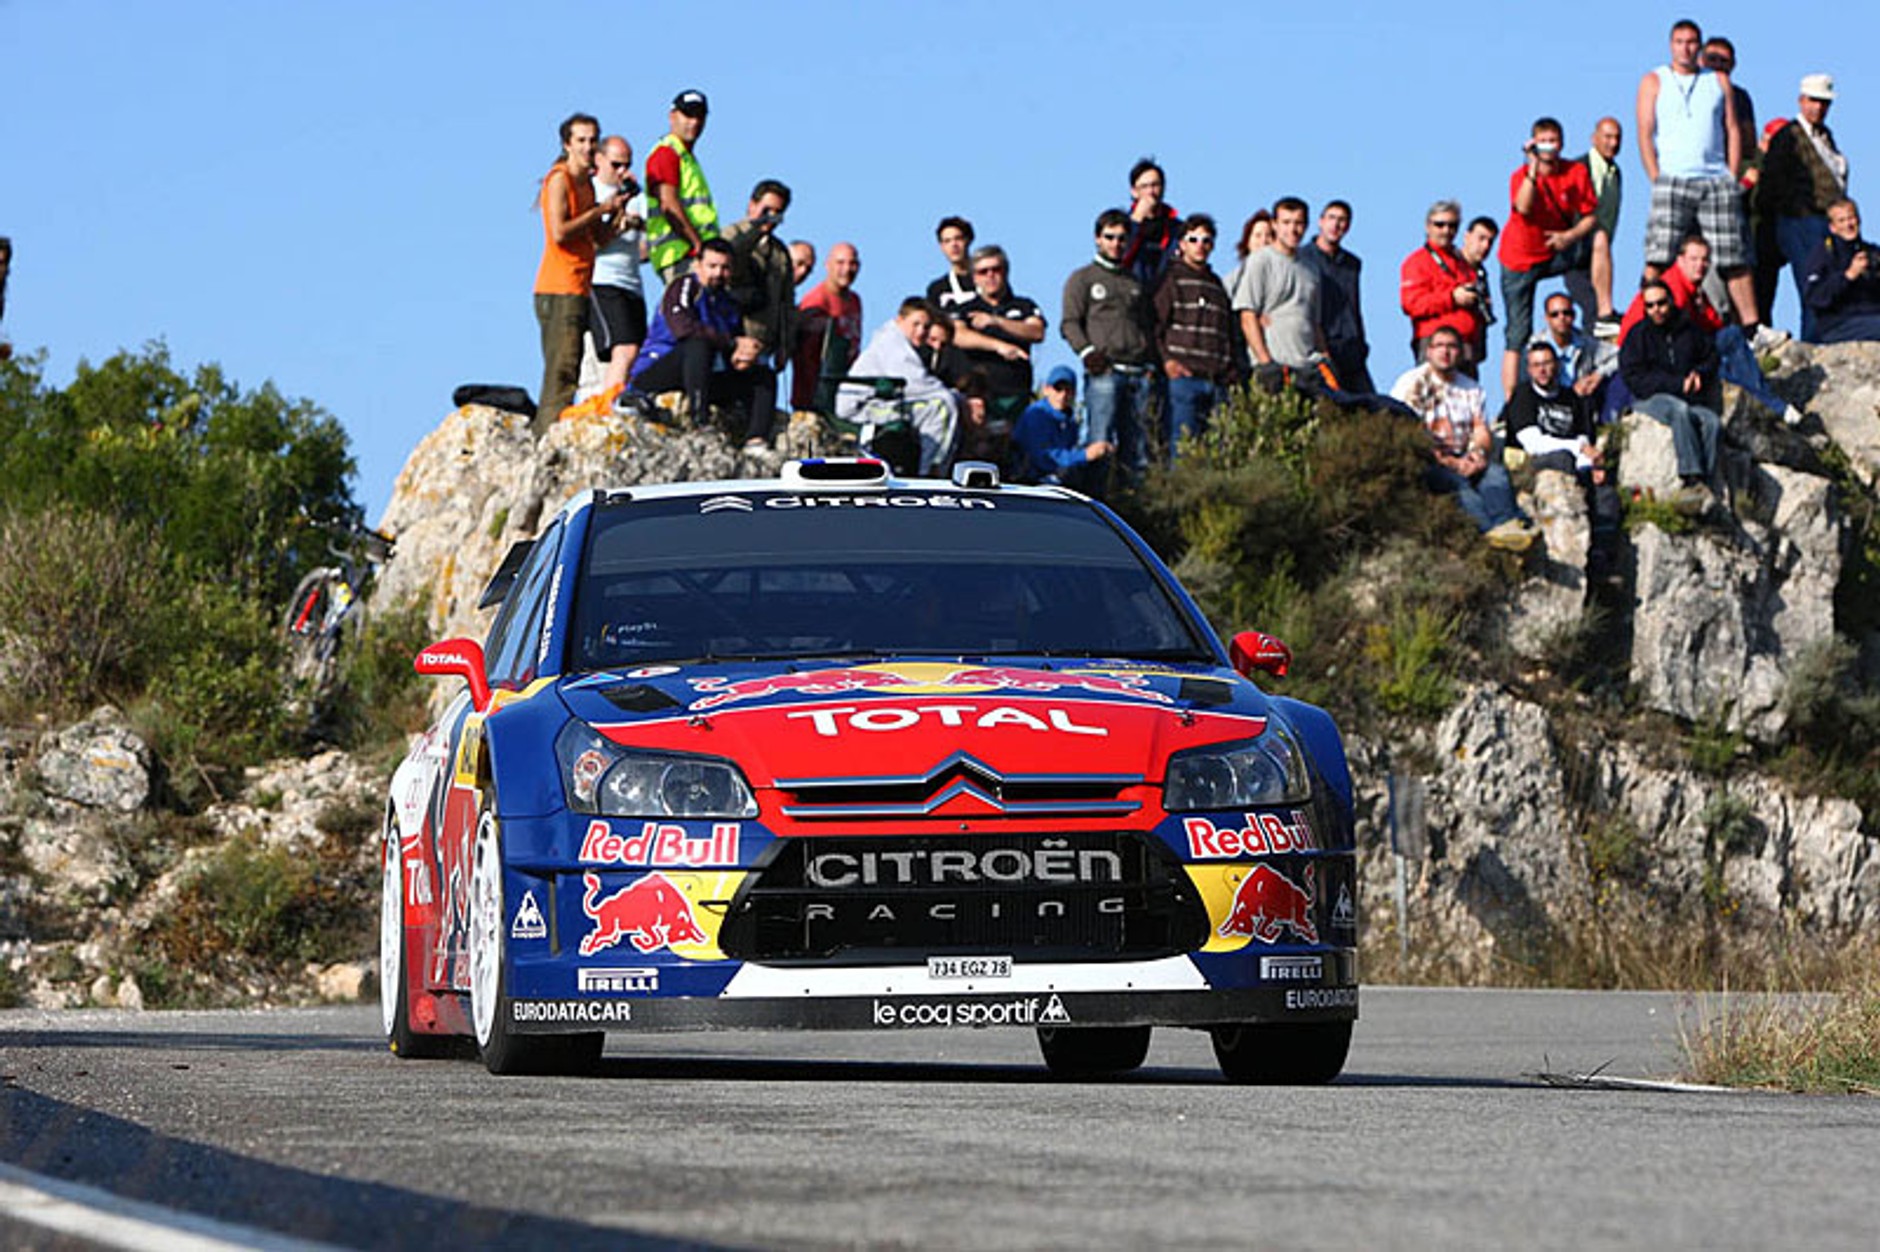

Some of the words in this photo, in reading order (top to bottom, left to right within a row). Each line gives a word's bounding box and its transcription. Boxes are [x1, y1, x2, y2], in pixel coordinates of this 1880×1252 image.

[422, 653, 469, 665] TOTAL
[787, 705, 1108, 736] TOTAL
[579, 821, 656, 865] Red
[652, 822, 740, 866] Bull
[1183, 813, 1269, 858] Red
[578, 968, 659, 991] PIRELLI
[1260, 956, 1322, 979] PIRELLI
[513, 1002, 631, 1021] EURODATACAR
[874, 999, 896, 1024] le
[900, 1004, 952, 1026] coq
[956, 998, 1039, 1026] sportif
